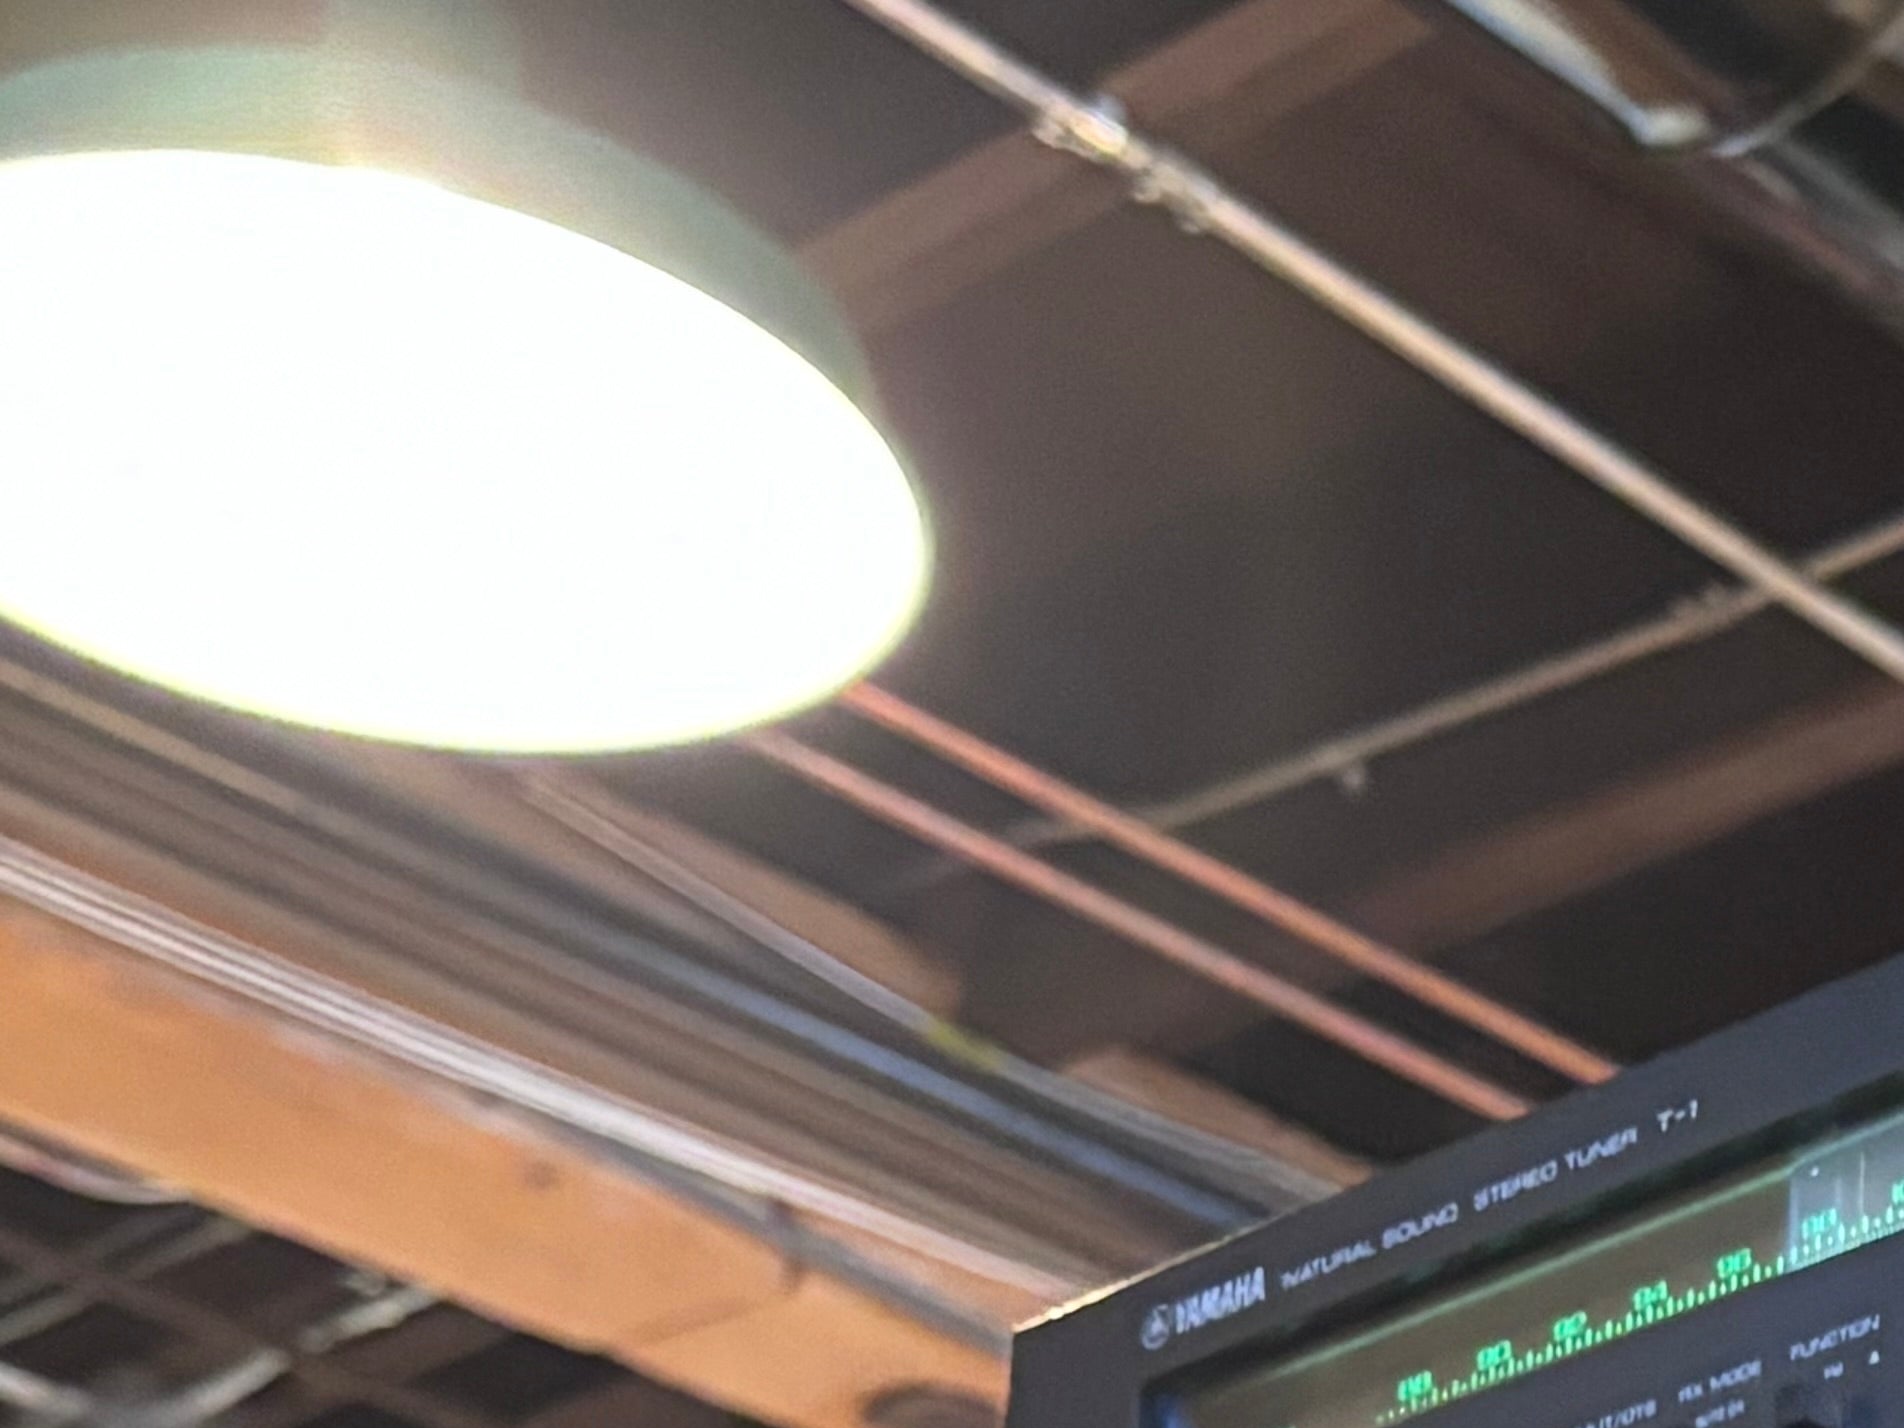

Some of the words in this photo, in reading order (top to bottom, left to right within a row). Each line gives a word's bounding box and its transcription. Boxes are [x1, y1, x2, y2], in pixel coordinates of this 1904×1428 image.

[1175, 1265, 1266, 1336] YAMAHA
[1279, 1239, 1378, 1291] NATURAL
[1381, 1201, 1460, 1251] SOUND
[1472, 1159, 1559, 1212] STEREO
[1563, 1126, 1640, 1173] TUNER
[1655, 1099, 1700, 1134] T-1
[1789, 1314, 1881, 1361] FUNCTION
[1709, 1358, 1763, 1391] MODE
